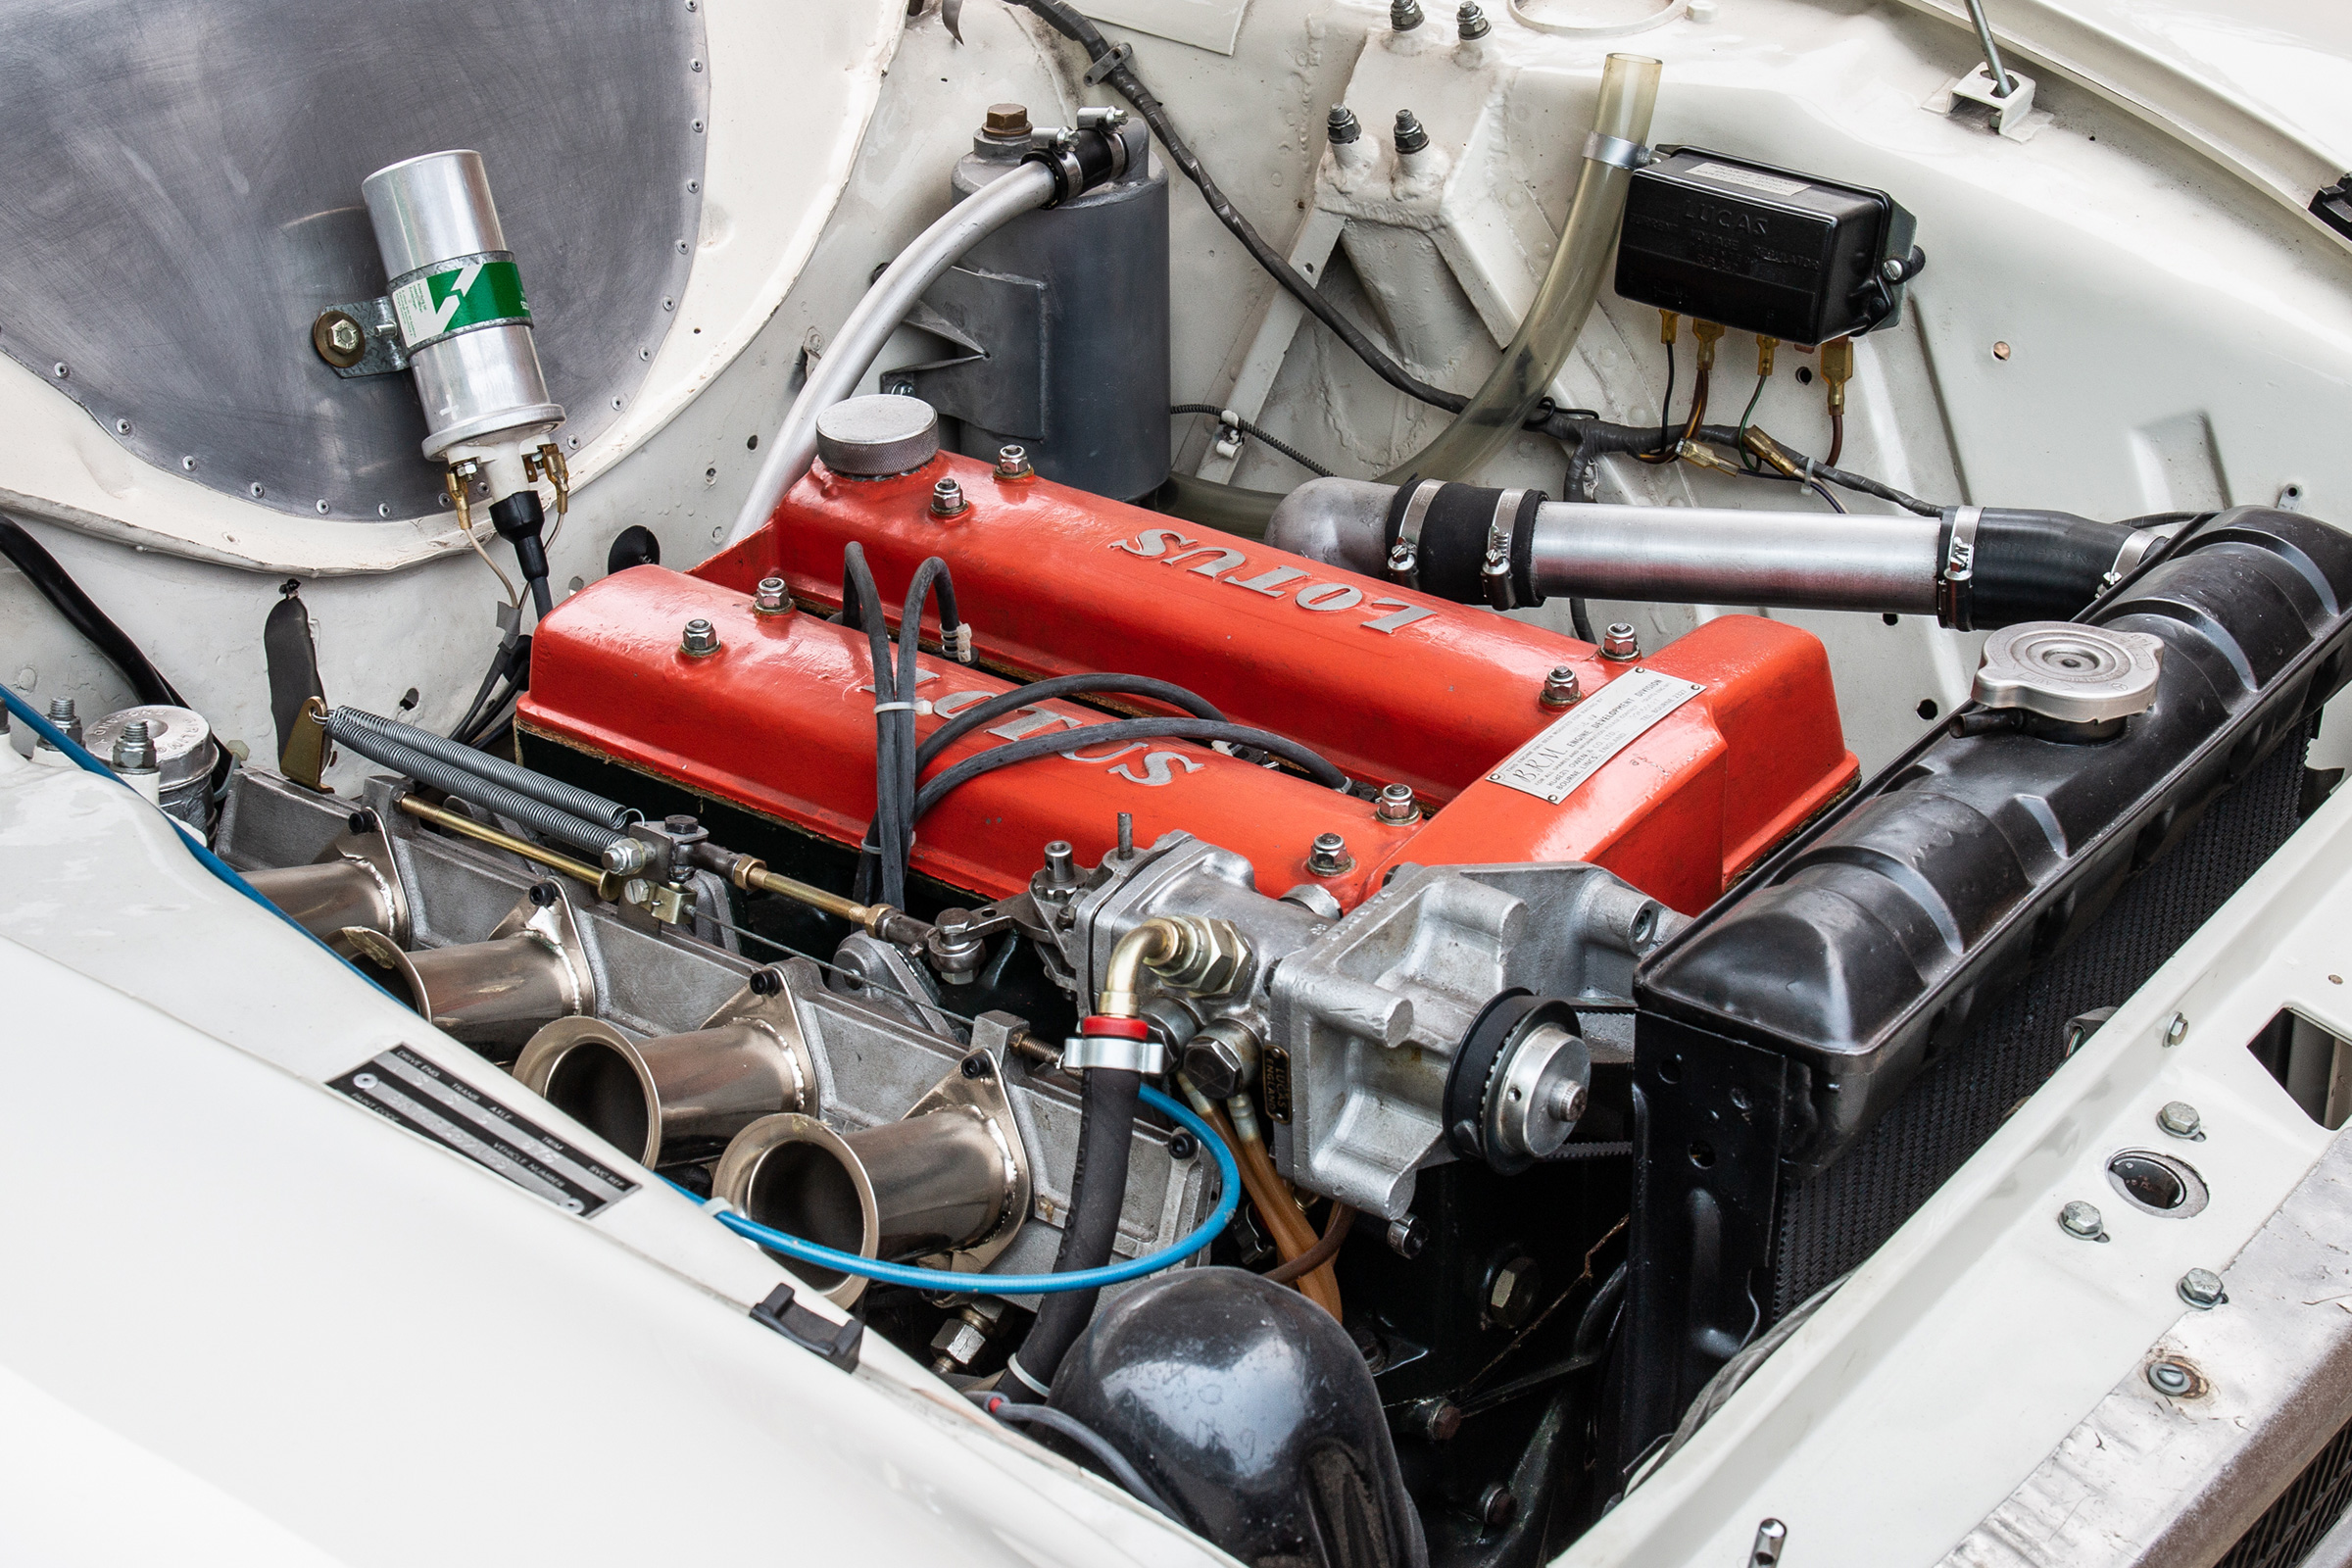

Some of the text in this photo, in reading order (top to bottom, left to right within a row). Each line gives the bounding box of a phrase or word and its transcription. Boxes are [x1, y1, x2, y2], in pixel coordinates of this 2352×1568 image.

[1684, 200, 1769, 236] LUCAS
[1690, 229, 1740, 250] VOLTAGE
[1752, 245, 1820, 270] REGULATOR
[1108, 528, 1438, 634] LOTUS
[1567, 730, 1592, 747] ENGINE
[1592, 699, 1634, 728] DEVELOPMENT
[1635, 679, 1662, 697] DIVISION
[1651, 699, 1674, 713] BOURNE
[1598, 733, 1626, 753] ENGLAND
[1569, 754, 1588, 767] OWEN
[397, 1051, 421, 1065] DRIVE
[1265, 1057, 1277, 1110] ENGLAND
[1275, 1067, 1287, 1108] LUCAS
[490, 1106, 512, 1119] AXLE
[543, 1137, 563, 1150] TRIM
[489, 1143, 564, 1187] VEHICLE NUMBER
[589, 1165, 608, 1177] SVC
